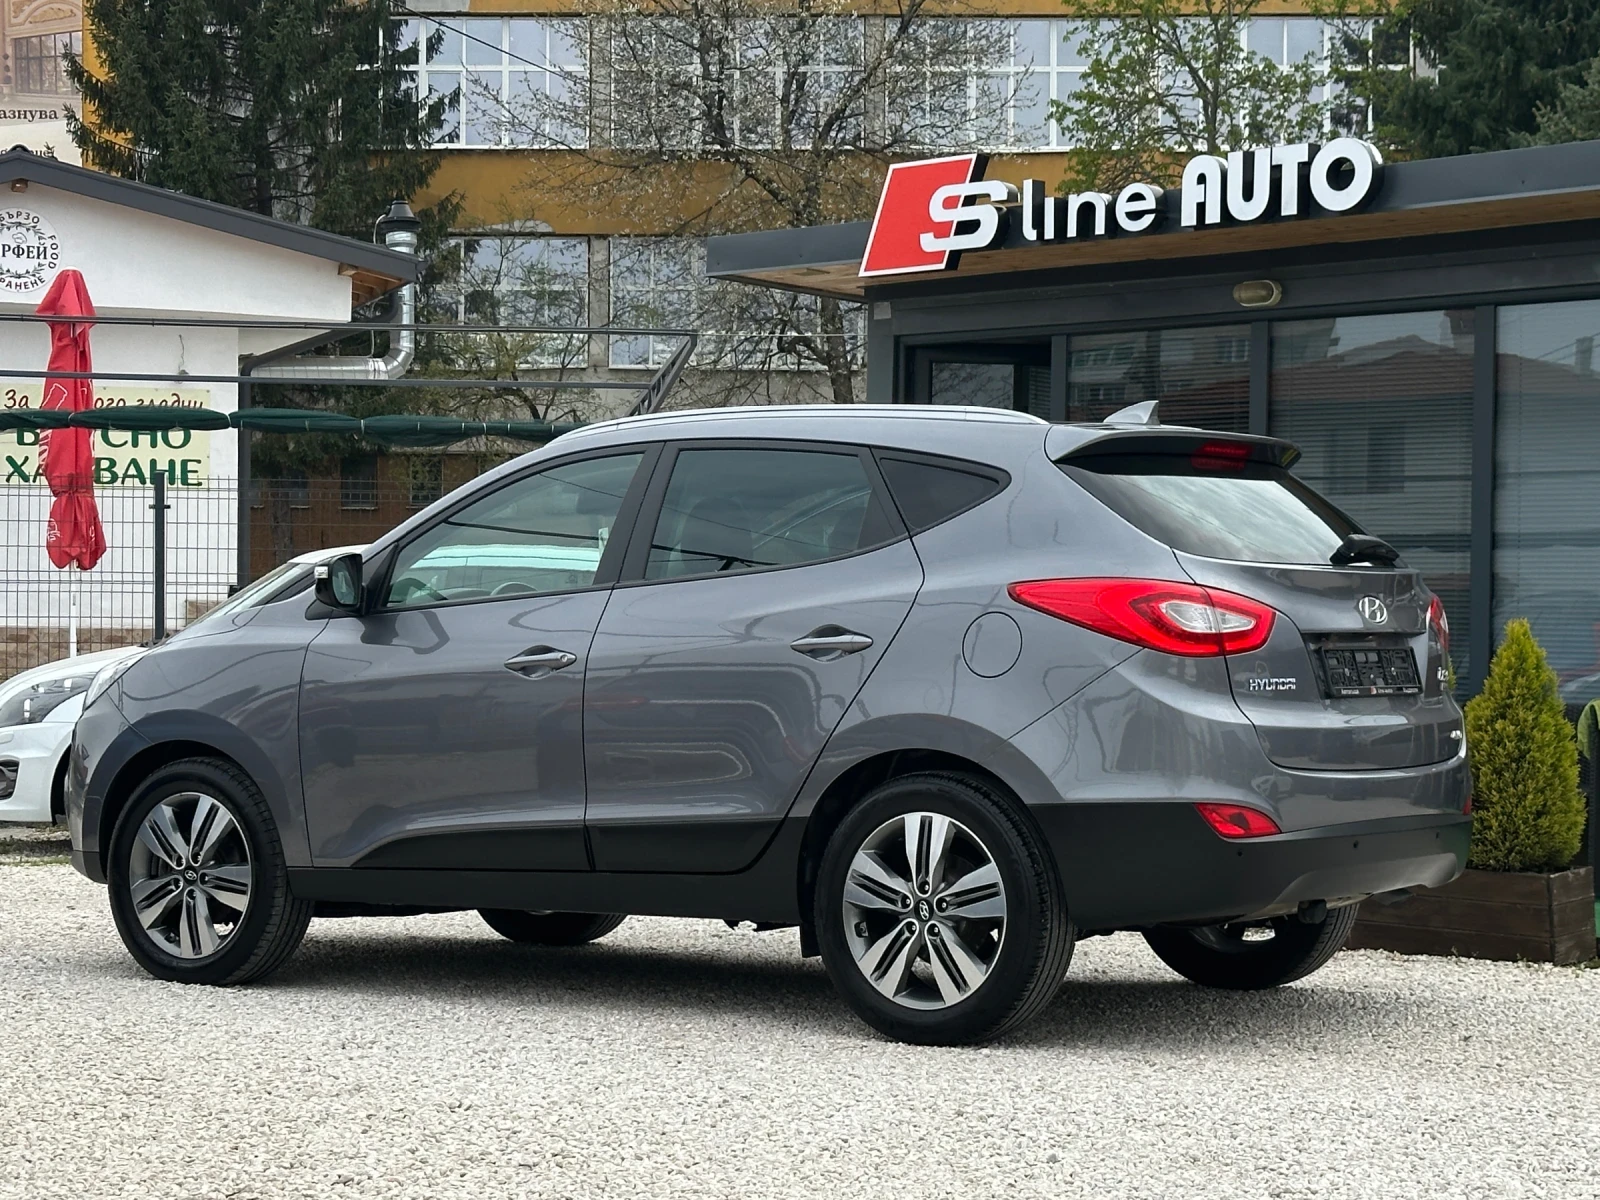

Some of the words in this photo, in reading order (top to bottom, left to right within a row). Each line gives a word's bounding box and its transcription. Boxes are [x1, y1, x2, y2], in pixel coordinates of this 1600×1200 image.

[1180, 138, 1378, 228] AUTO
[48, 235, 59, 269] FOOD
[4, 389, 30, 409] За
[1249, 677, 1297, 691] HYUNDAI
